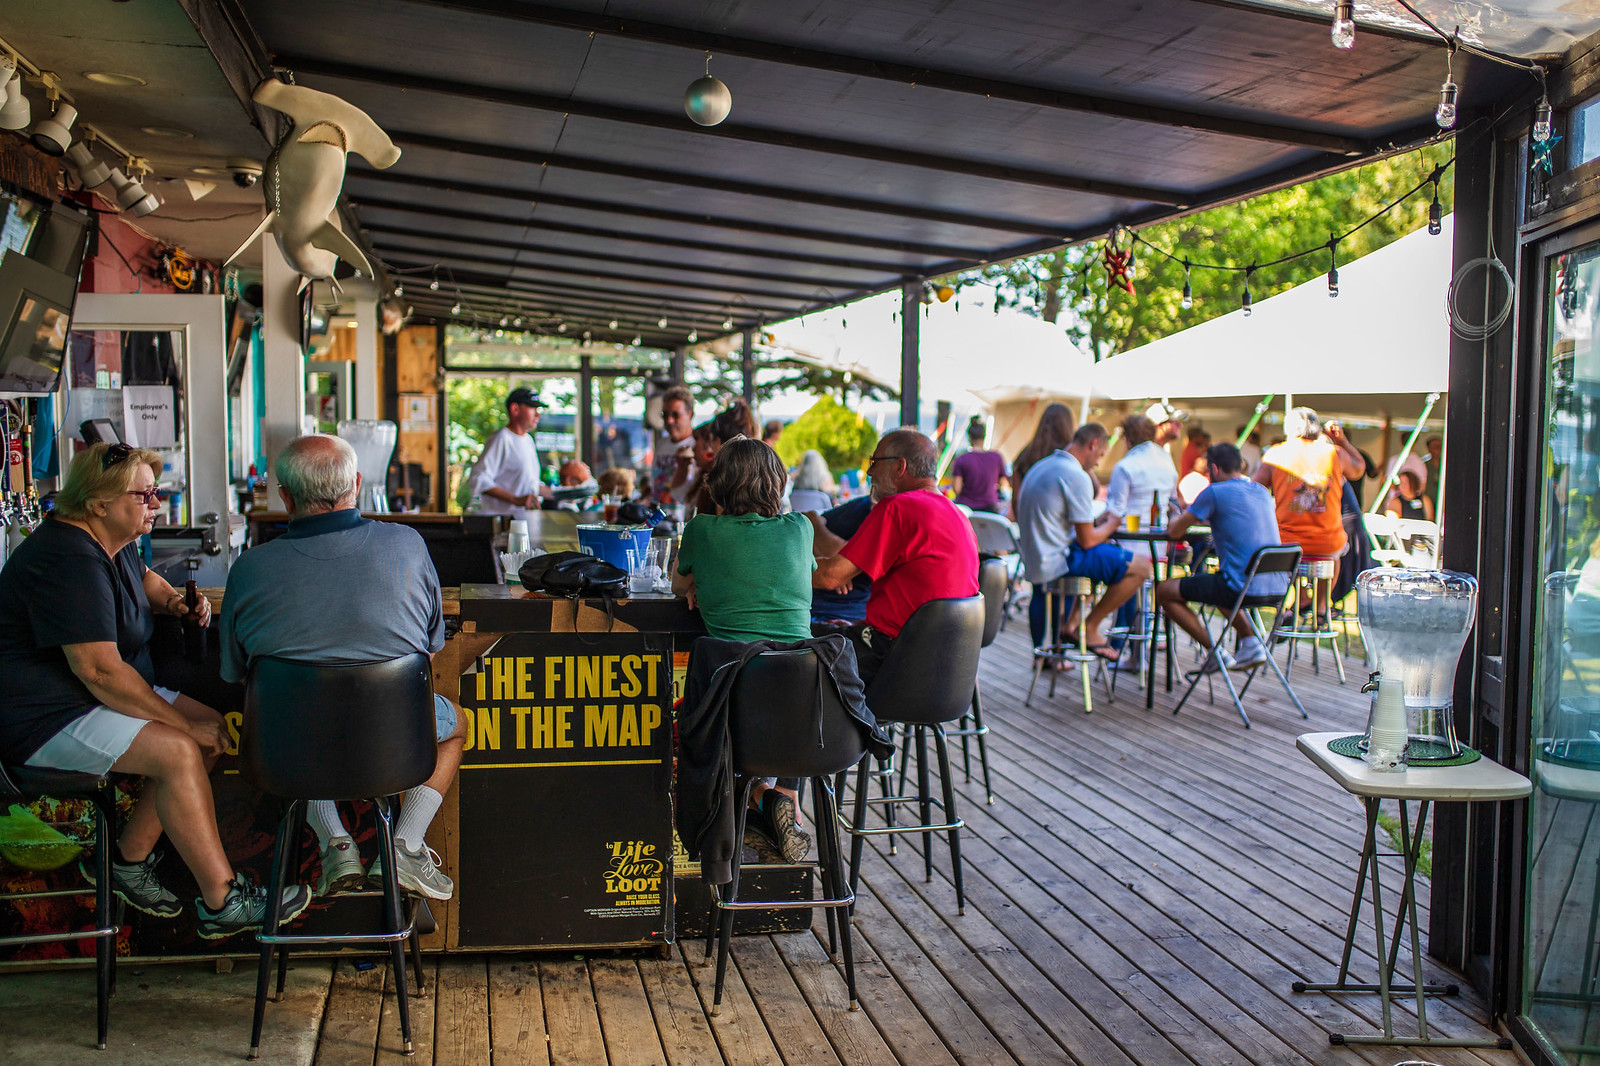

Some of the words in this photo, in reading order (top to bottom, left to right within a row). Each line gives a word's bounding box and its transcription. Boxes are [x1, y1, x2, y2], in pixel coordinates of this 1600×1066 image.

[130, 403, 168, 411] Employee's
[476, 656, 535, 701] THE
[545, 654, 662, 699] FINEST
[510, 705, 574, 750] THE
[584, 703, 662, 748] MAP
[612, 840, 657, 863] Life
[602, 855, 655, 880] Love
[605, 878, 661, 893] LOOT
